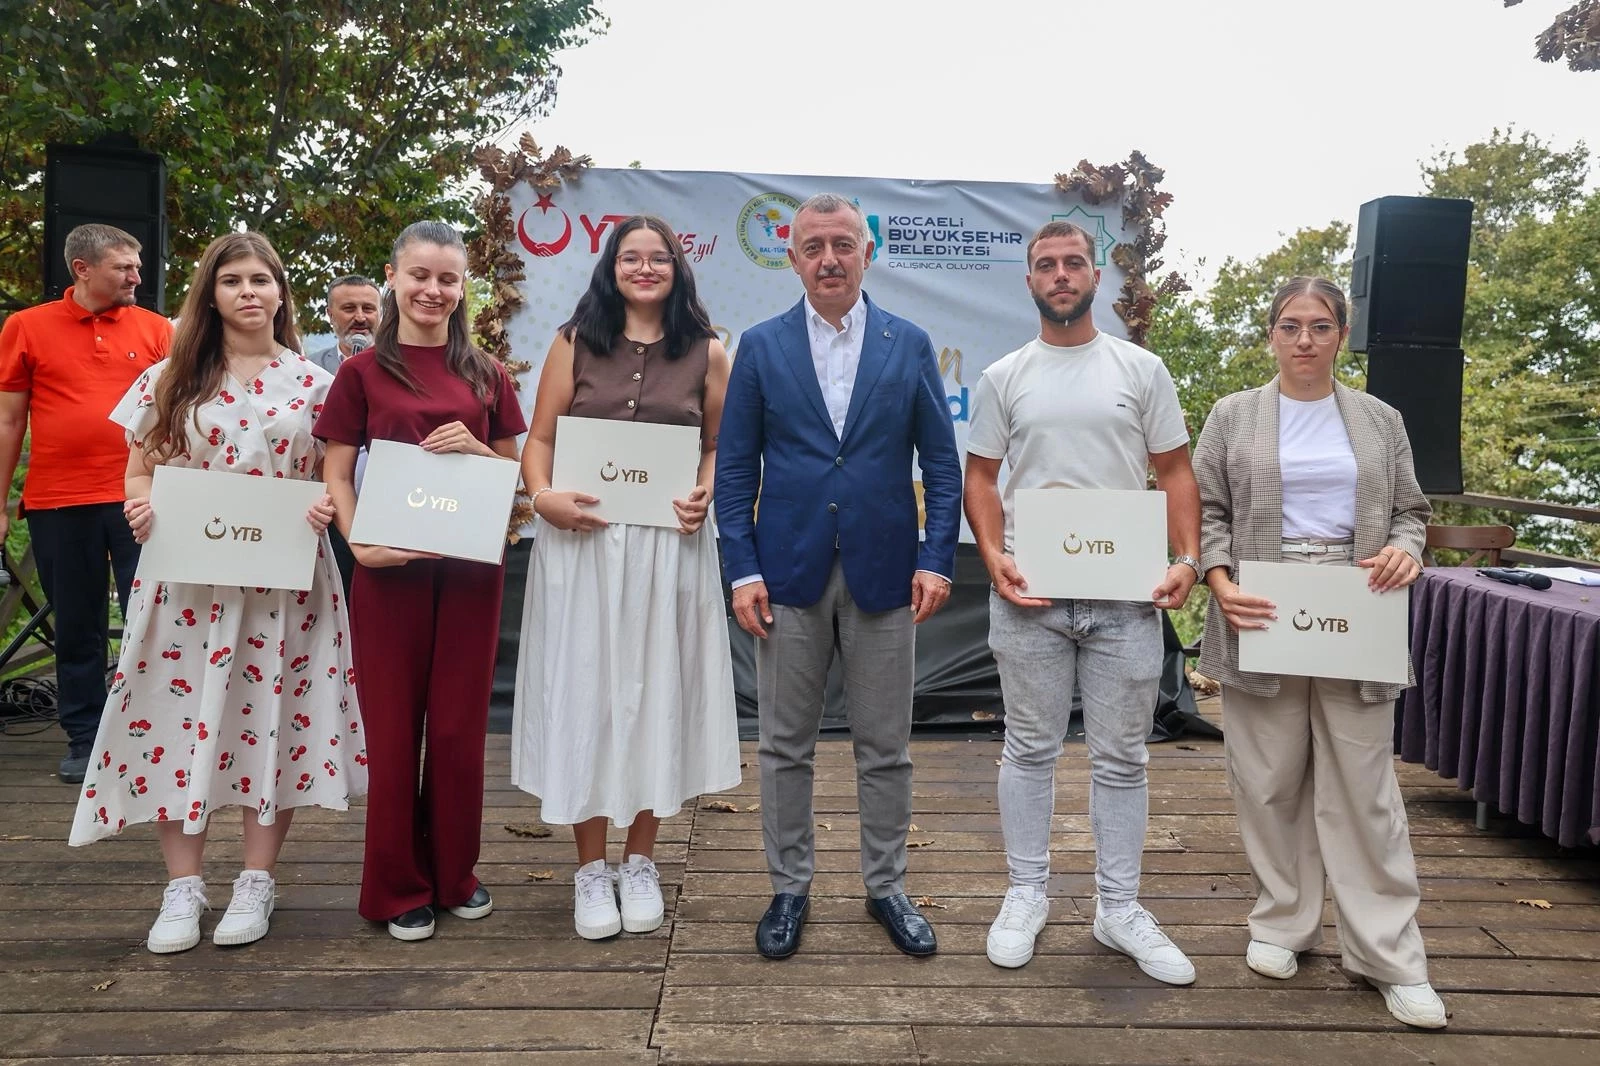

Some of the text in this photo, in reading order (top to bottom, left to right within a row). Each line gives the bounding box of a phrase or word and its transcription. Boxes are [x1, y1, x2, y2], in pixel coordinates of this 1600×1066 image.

[888, 261, 990, 271] ÇALIŞINCA OLUYOR
[621, 468, 649, 484] YTB
[430, 495, 458, 513] YTB
[230, 525, 263, 542] YTB
[1085, 540, 1115, 555] YTB
[1316, 616, 1349, 633] YTB
